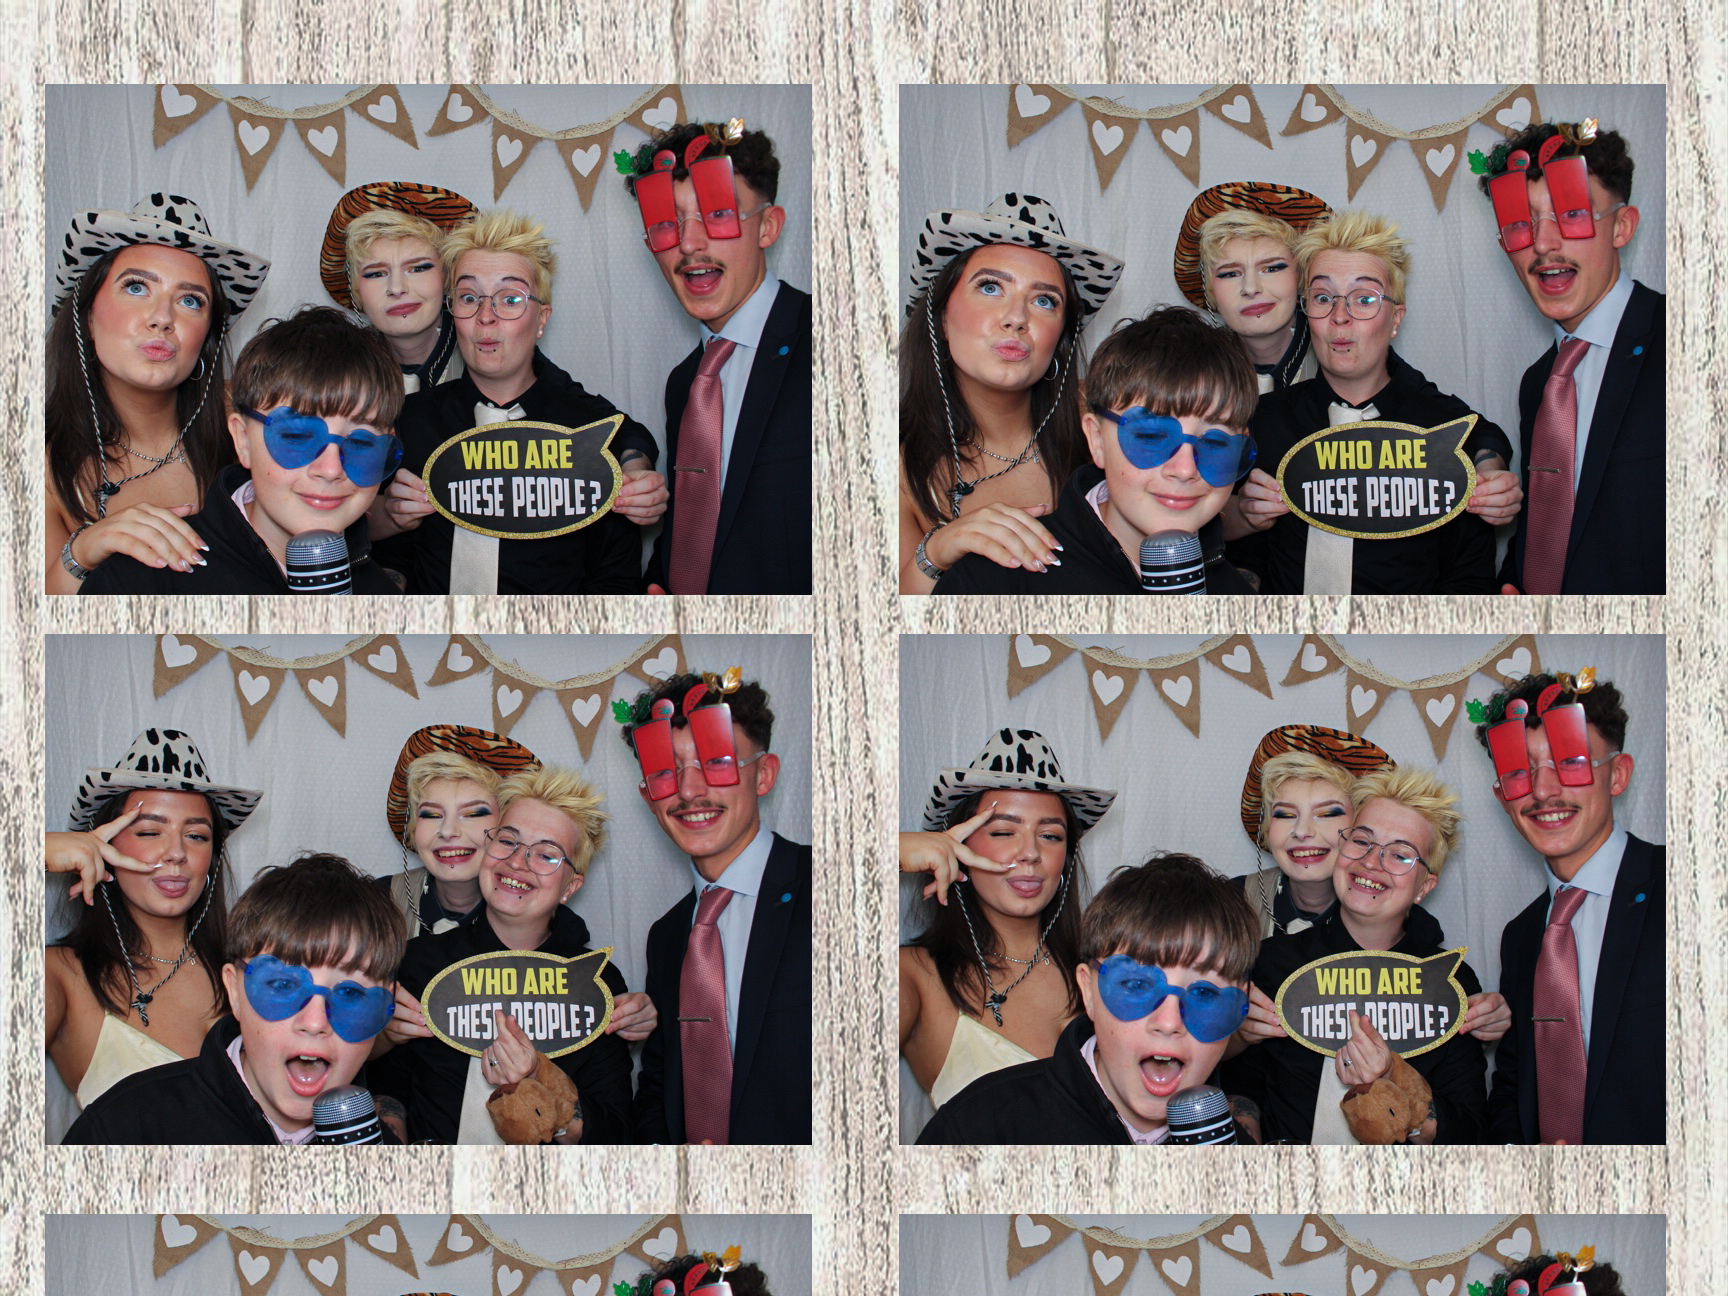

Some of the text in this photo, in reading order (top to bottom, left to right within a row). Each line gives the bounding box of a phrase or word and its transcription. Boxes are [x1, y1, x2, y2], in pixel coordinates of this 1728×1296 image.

[461, 438, 574, 470] WHO ARE
[1315, 438, 1428, 470] WHO ARE
[448, 477, 505, 517] THESE
[1302, 477, 1359, 517] THESE
[461, 967, 569, 996] WHO ARE
[1315, 967, 1423, 996] WHO ARE
